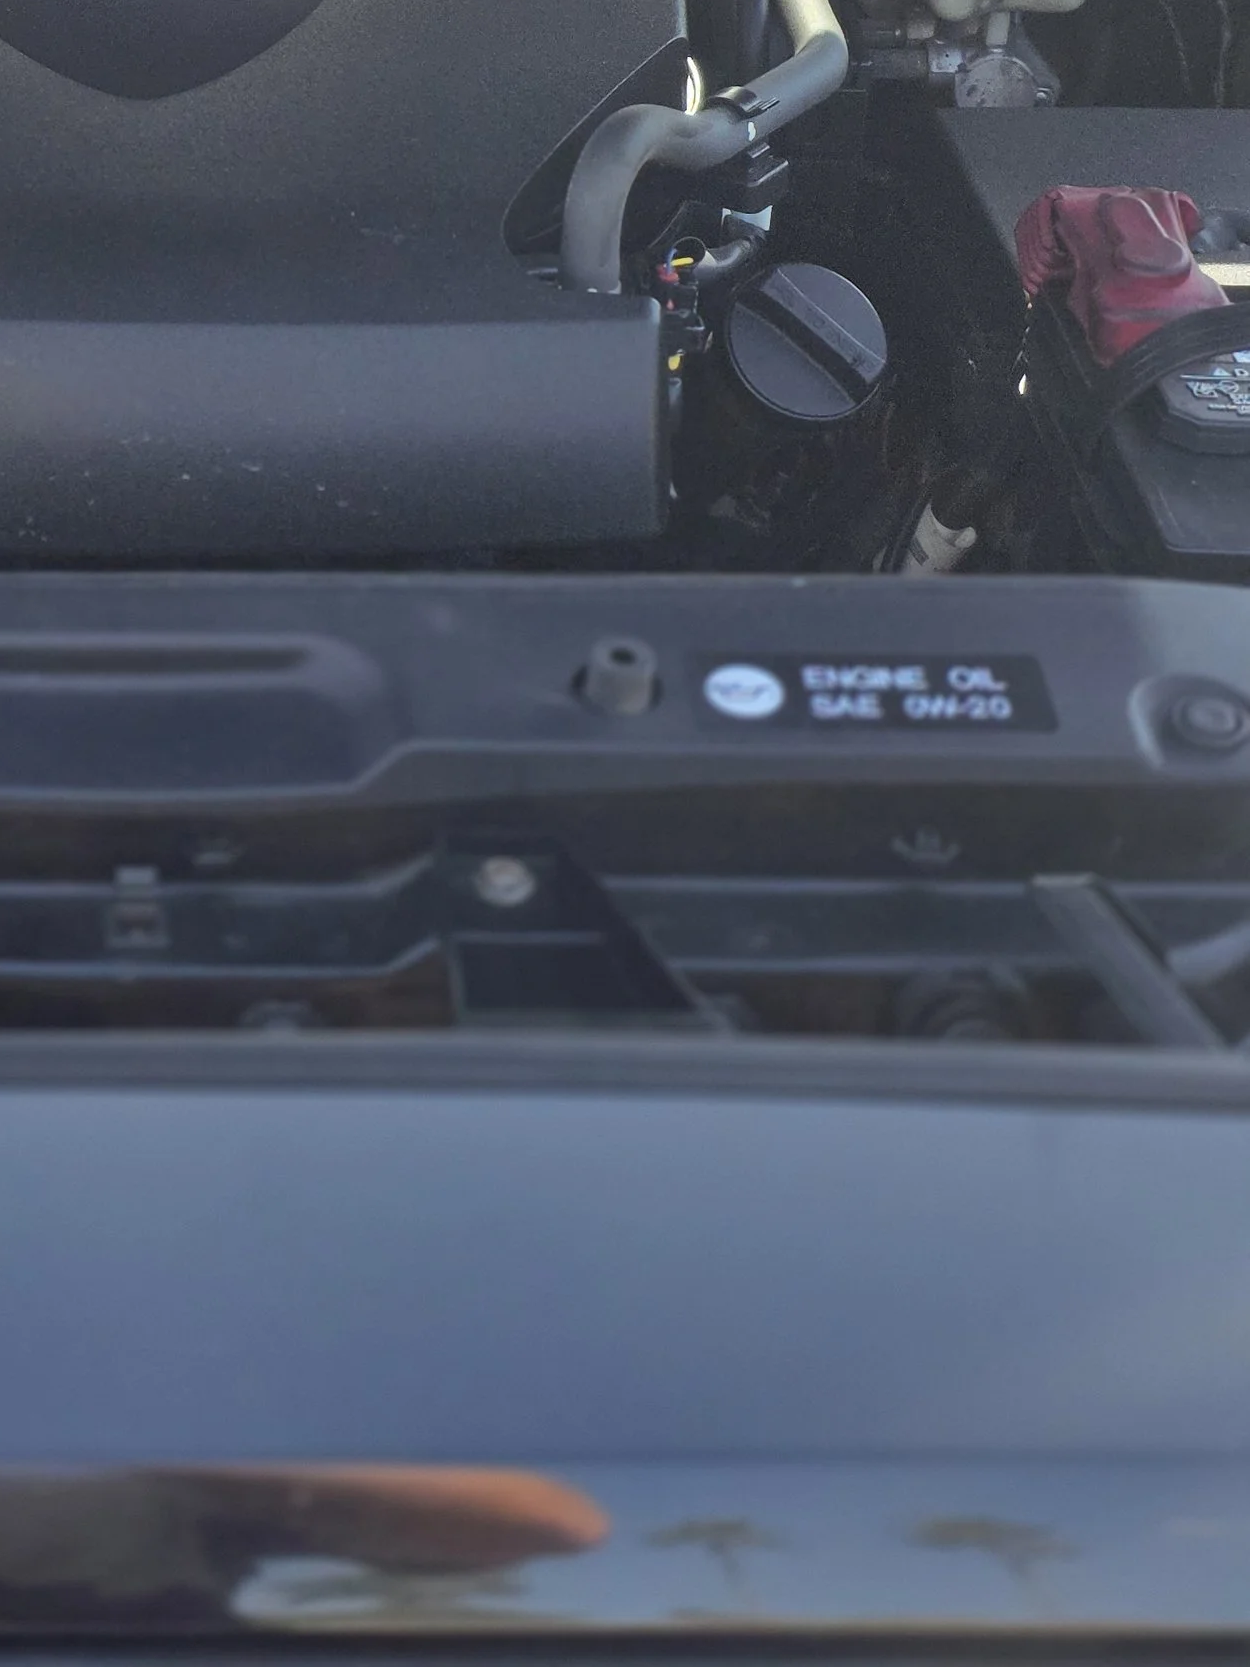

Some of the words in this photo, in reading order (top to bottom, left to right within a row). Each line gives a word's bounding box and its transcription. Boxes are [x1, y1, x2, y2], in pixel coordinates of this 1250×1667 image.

[800, 665, 928, 691] ENGINE
[947, 666, 1007, 692] OIL
[809, 695, 883, 719] SAE
[903, 694, 1012, 720] 0W-20
